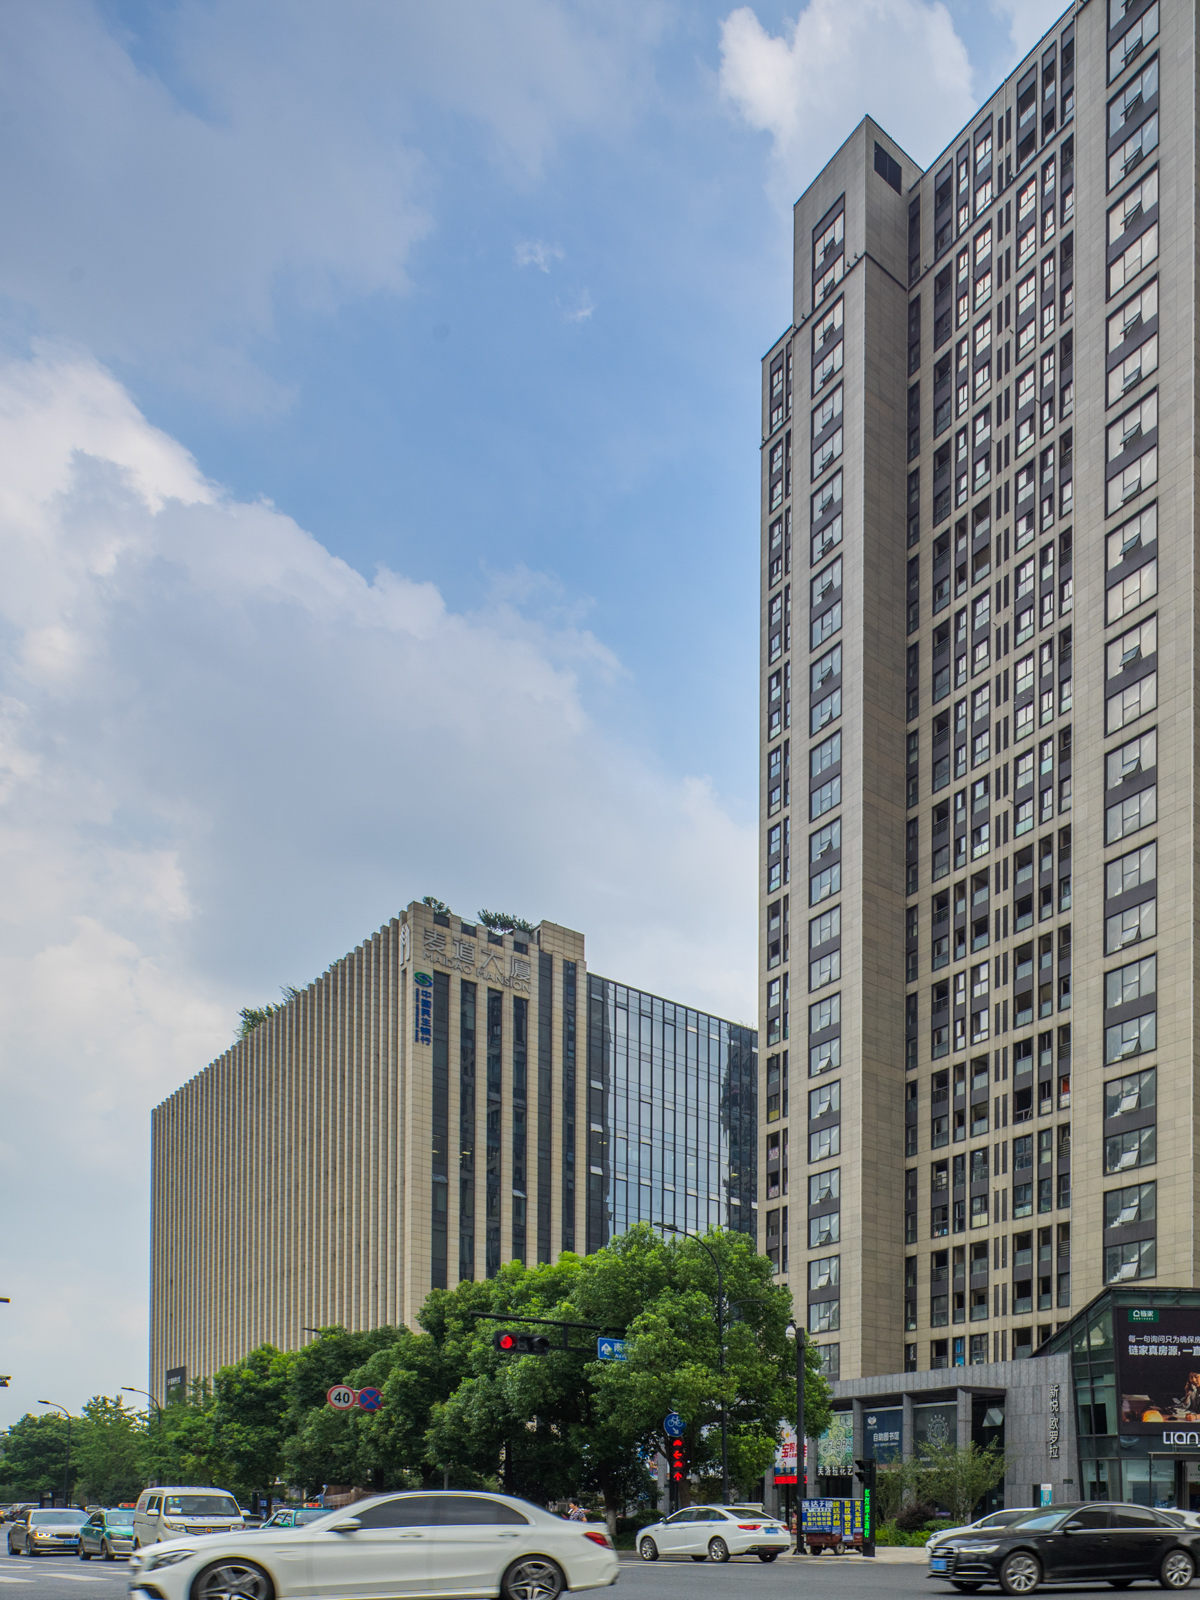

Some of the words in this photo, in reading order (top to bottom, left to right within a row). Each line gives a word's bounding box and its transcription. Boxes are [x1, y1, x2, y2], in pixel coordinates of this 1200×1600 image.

[423, 951, 473, 975] MAIDAO
[475, 968, 531, 994] MANSION
[424, 928, 530, 982] 麦道大厦
[420, 990, 431, 1046] 中国民生银行
[334, 1391, 350, 1404] 40
[817, 1465, 853, 1476] 芙洛拉花艺
